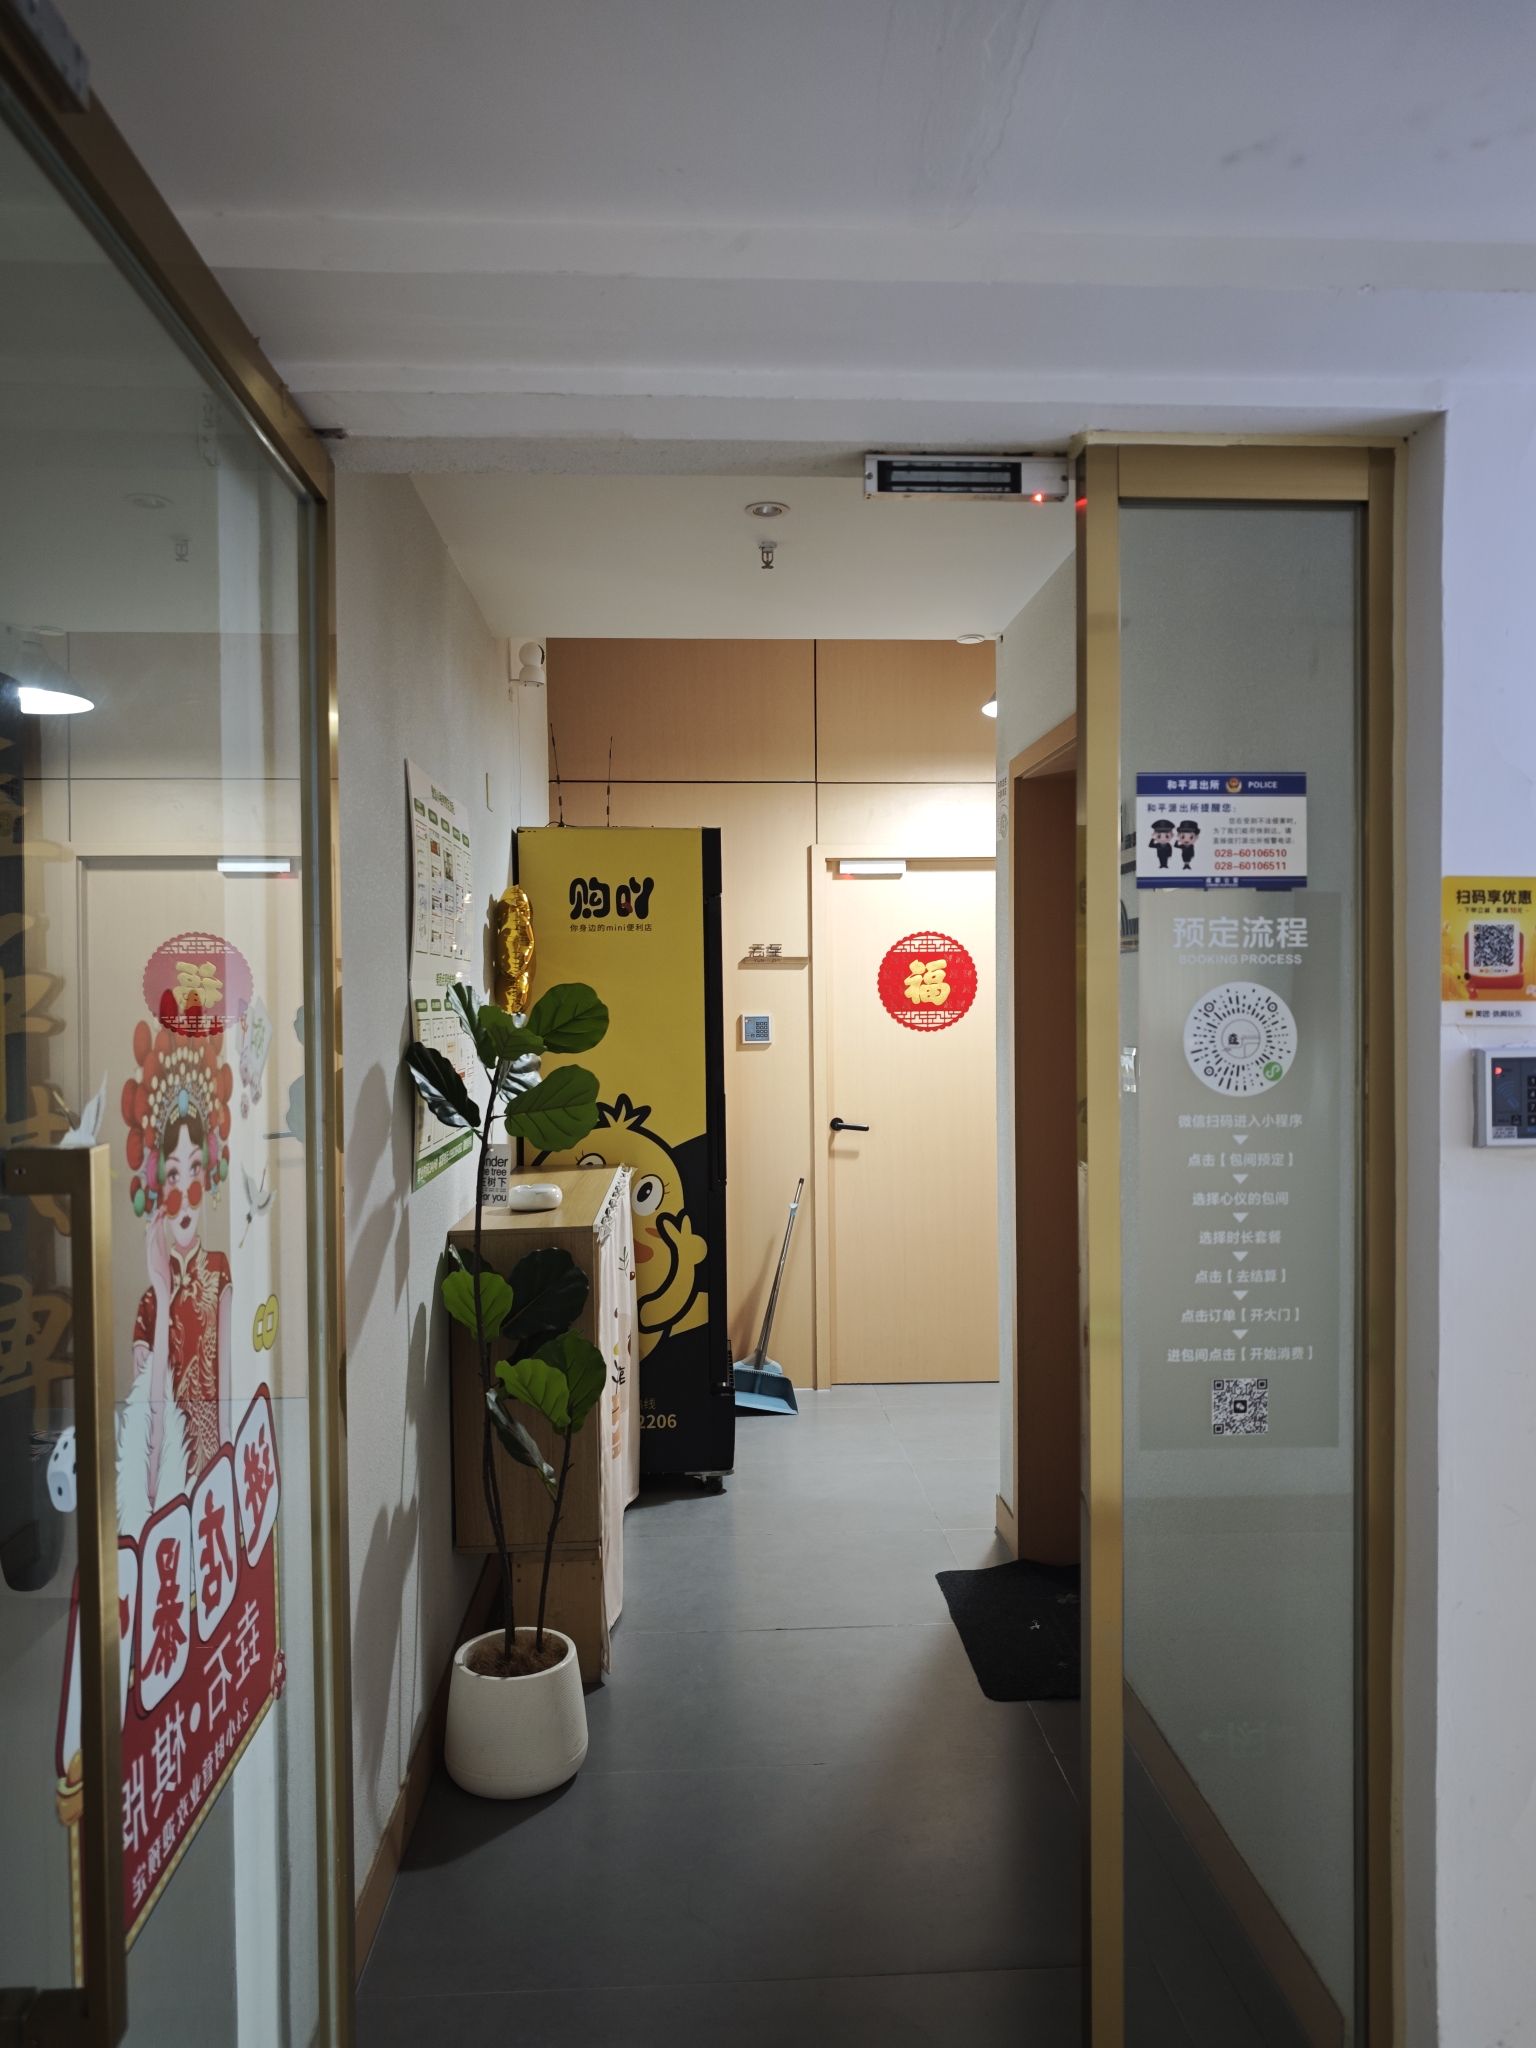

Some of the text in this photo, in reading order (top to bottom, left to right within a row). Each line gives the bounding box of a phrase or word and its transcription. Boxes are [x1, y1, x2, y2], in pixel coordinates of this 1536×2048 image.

[1167, 779, 1278, 791] 和平派出所 POLICE
[1214, 848, 1287, 858] 028-60106510
[1214, 861, 1286, 871] 028-60106511
[1456, 889, 1532, 905] 扫码享优惠
[569, 923, 653, 933] 你身边的mini便利店
[1172, 916, 1309, 949] 预定流程
[1178, 953, 1303, 965] BOOKING PROCESS
[904, 959, 951, 1006] 福
[1178, 1113, 1303, 1129] 微信扫码进入小程序
[485, 1156, 508, 1167] nder
[491, 1168, 507, 1176] tree
[492, 1194, 507, 1204] you
[1192, 1191, 1289, 1207] 选择心仪的包间
[1199, 1230, 1282, 1245] 选择时长套餐
